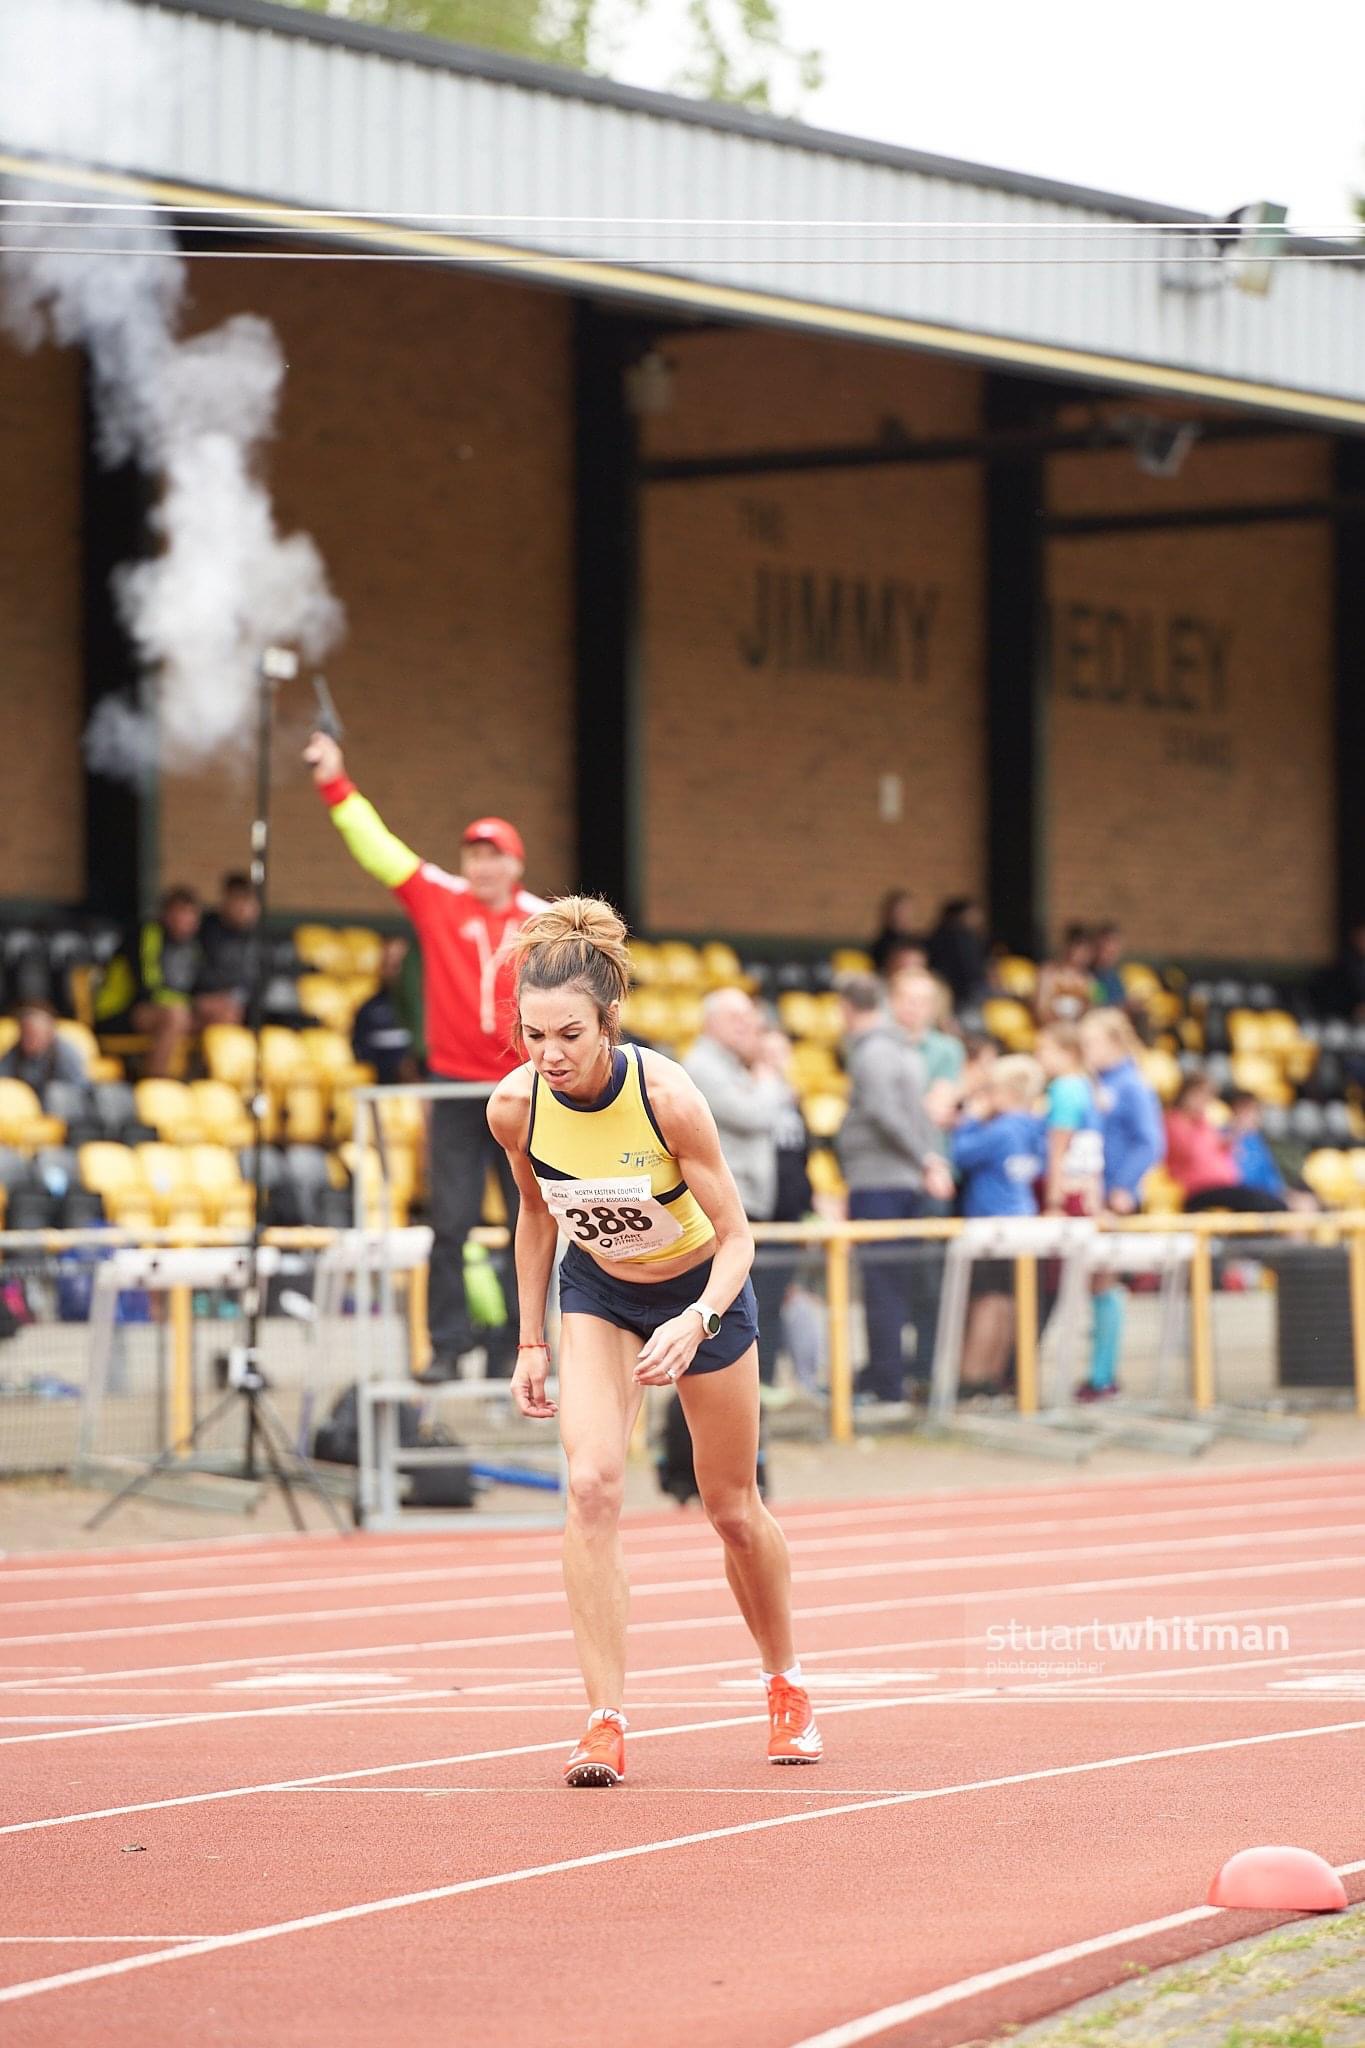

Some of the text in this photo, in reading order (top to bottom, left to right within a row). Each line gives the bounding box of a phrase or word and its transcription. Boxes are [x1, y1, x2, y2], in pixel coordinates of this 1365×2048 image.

[737, 562, 940, 684] JIMMY
[594, 1188, 616, 1196] EASTERN
[617, 1186, 644, 1195] COUNTIES
[565, 1206, 653, 1240] 388
[613, 1233, 641, 1241] START
